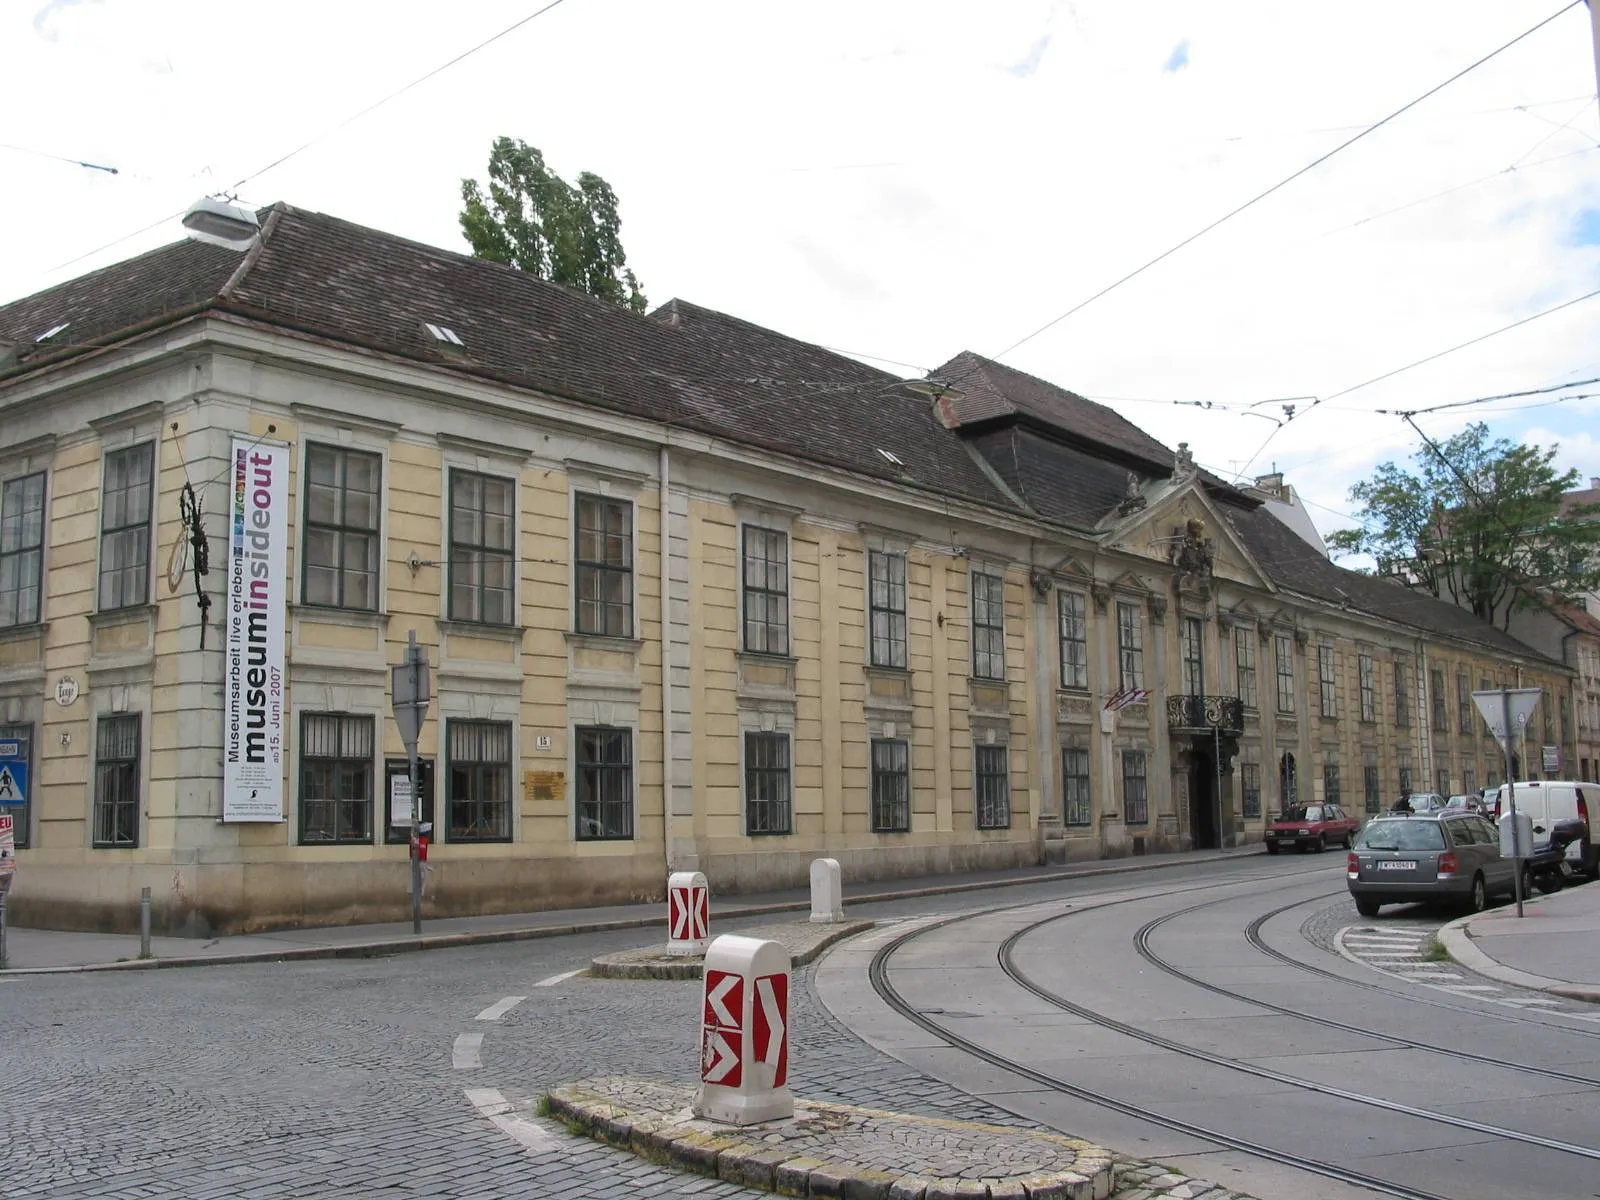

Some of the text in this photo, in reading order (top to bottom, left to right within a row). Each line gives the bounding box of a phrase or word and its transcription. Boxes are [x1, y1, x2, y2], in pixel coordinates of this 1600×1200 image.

[228, 556, 243, 763] Museumsarbeit live erleben
[243, 452, 273, 763] museuminsideout
[270, 665, 281, 696] 2007
[270, 700, 281, 729] Juni
